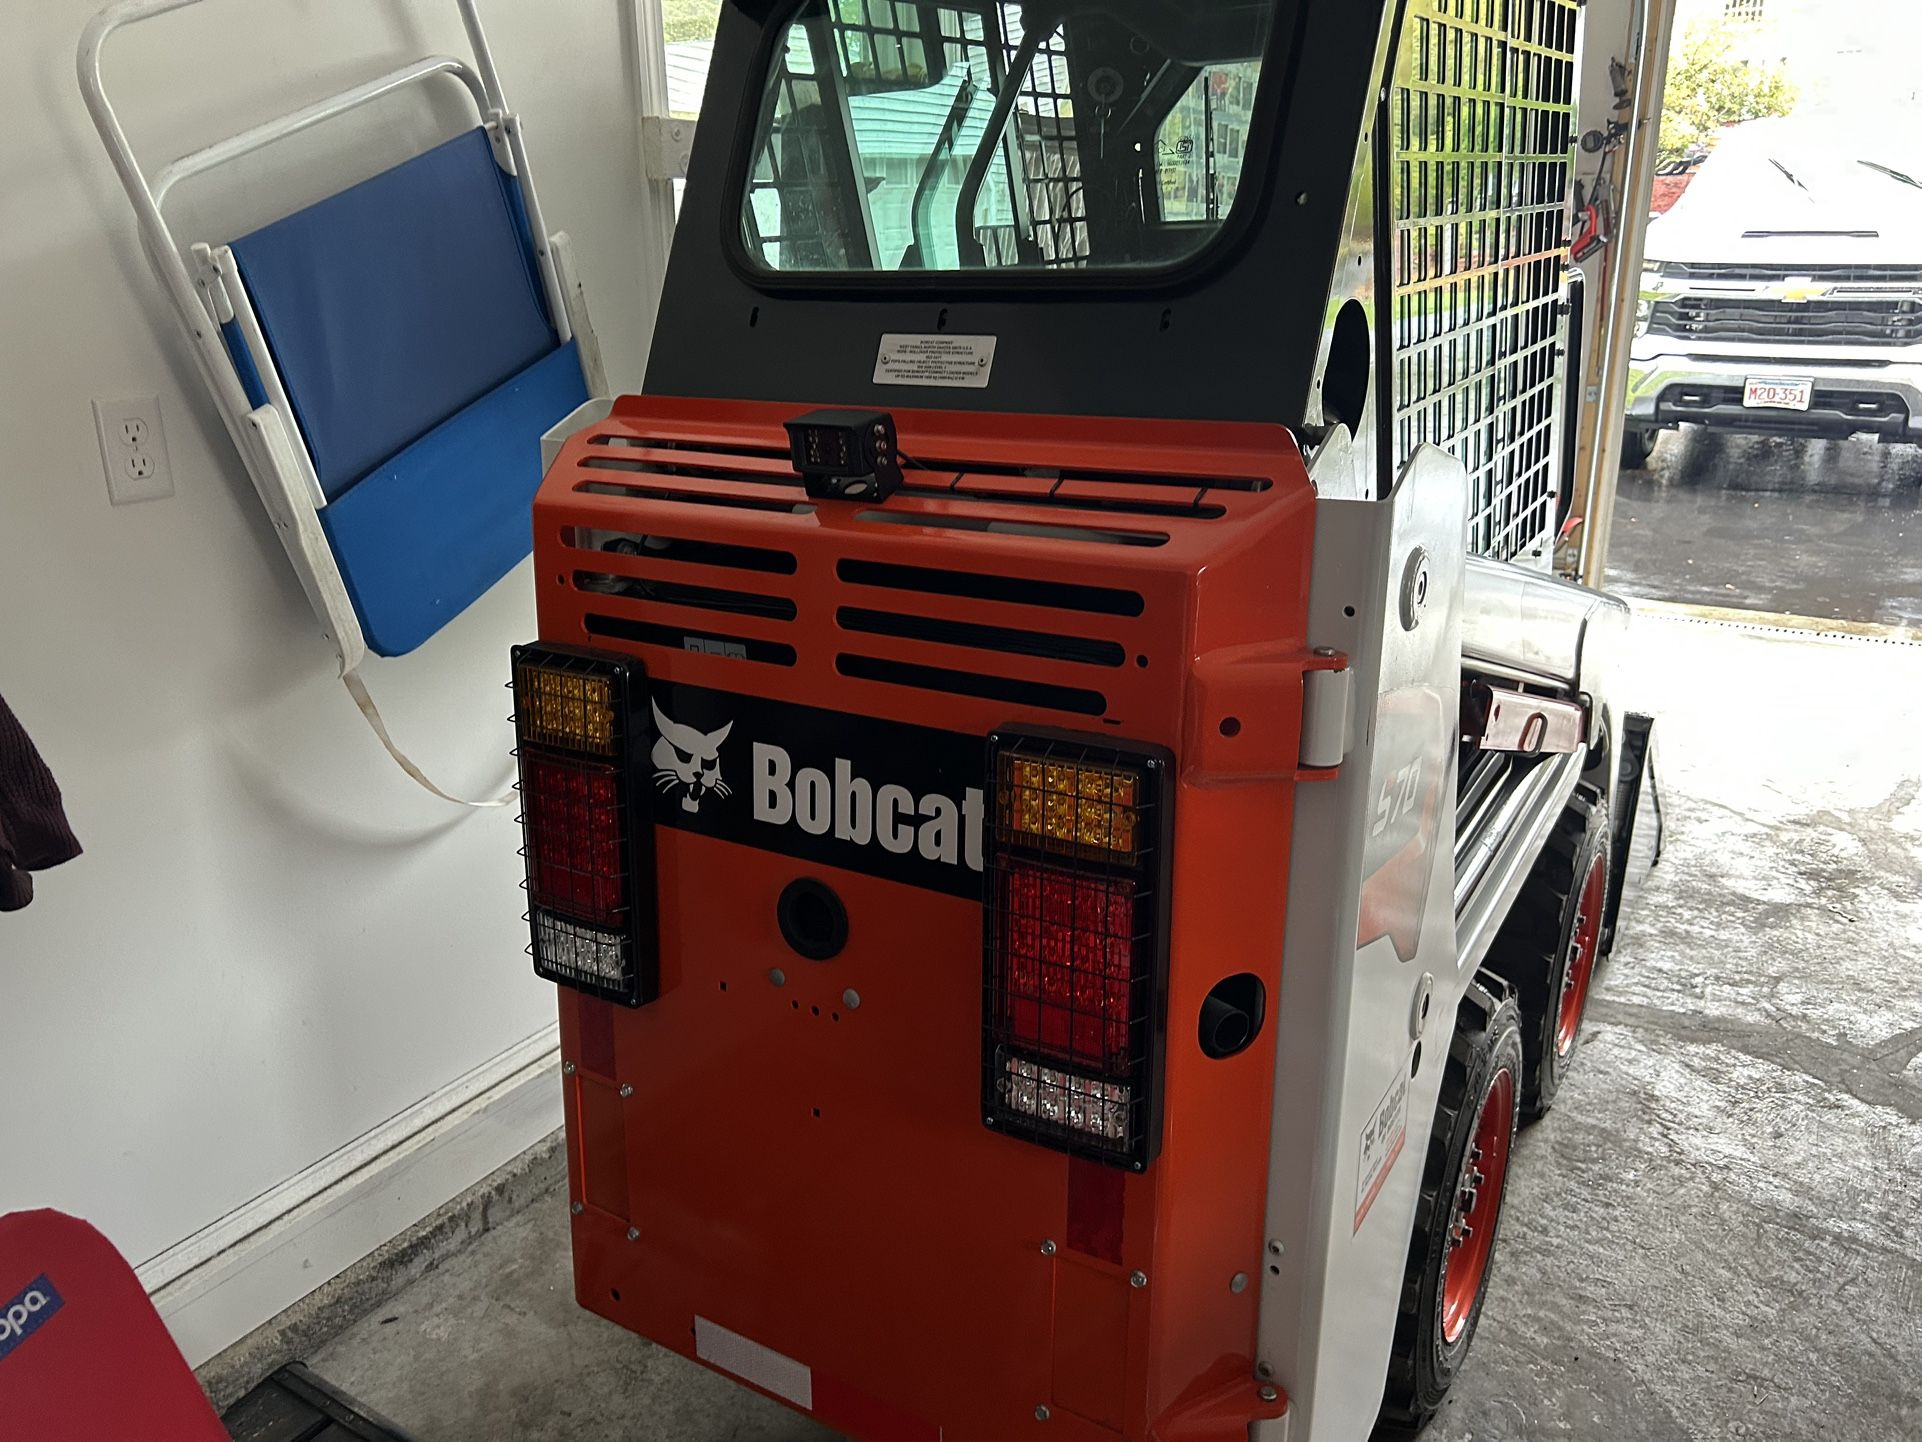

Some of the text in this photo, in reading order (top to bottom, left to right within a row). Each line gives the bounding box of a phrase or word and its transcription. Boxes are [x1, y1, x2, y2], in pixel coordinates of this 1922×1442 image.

[1748, 386, 1805, 404] M20-351
[752, 742, 984, 872] Bobcat
[1372, 756, 1418, 832] S70
